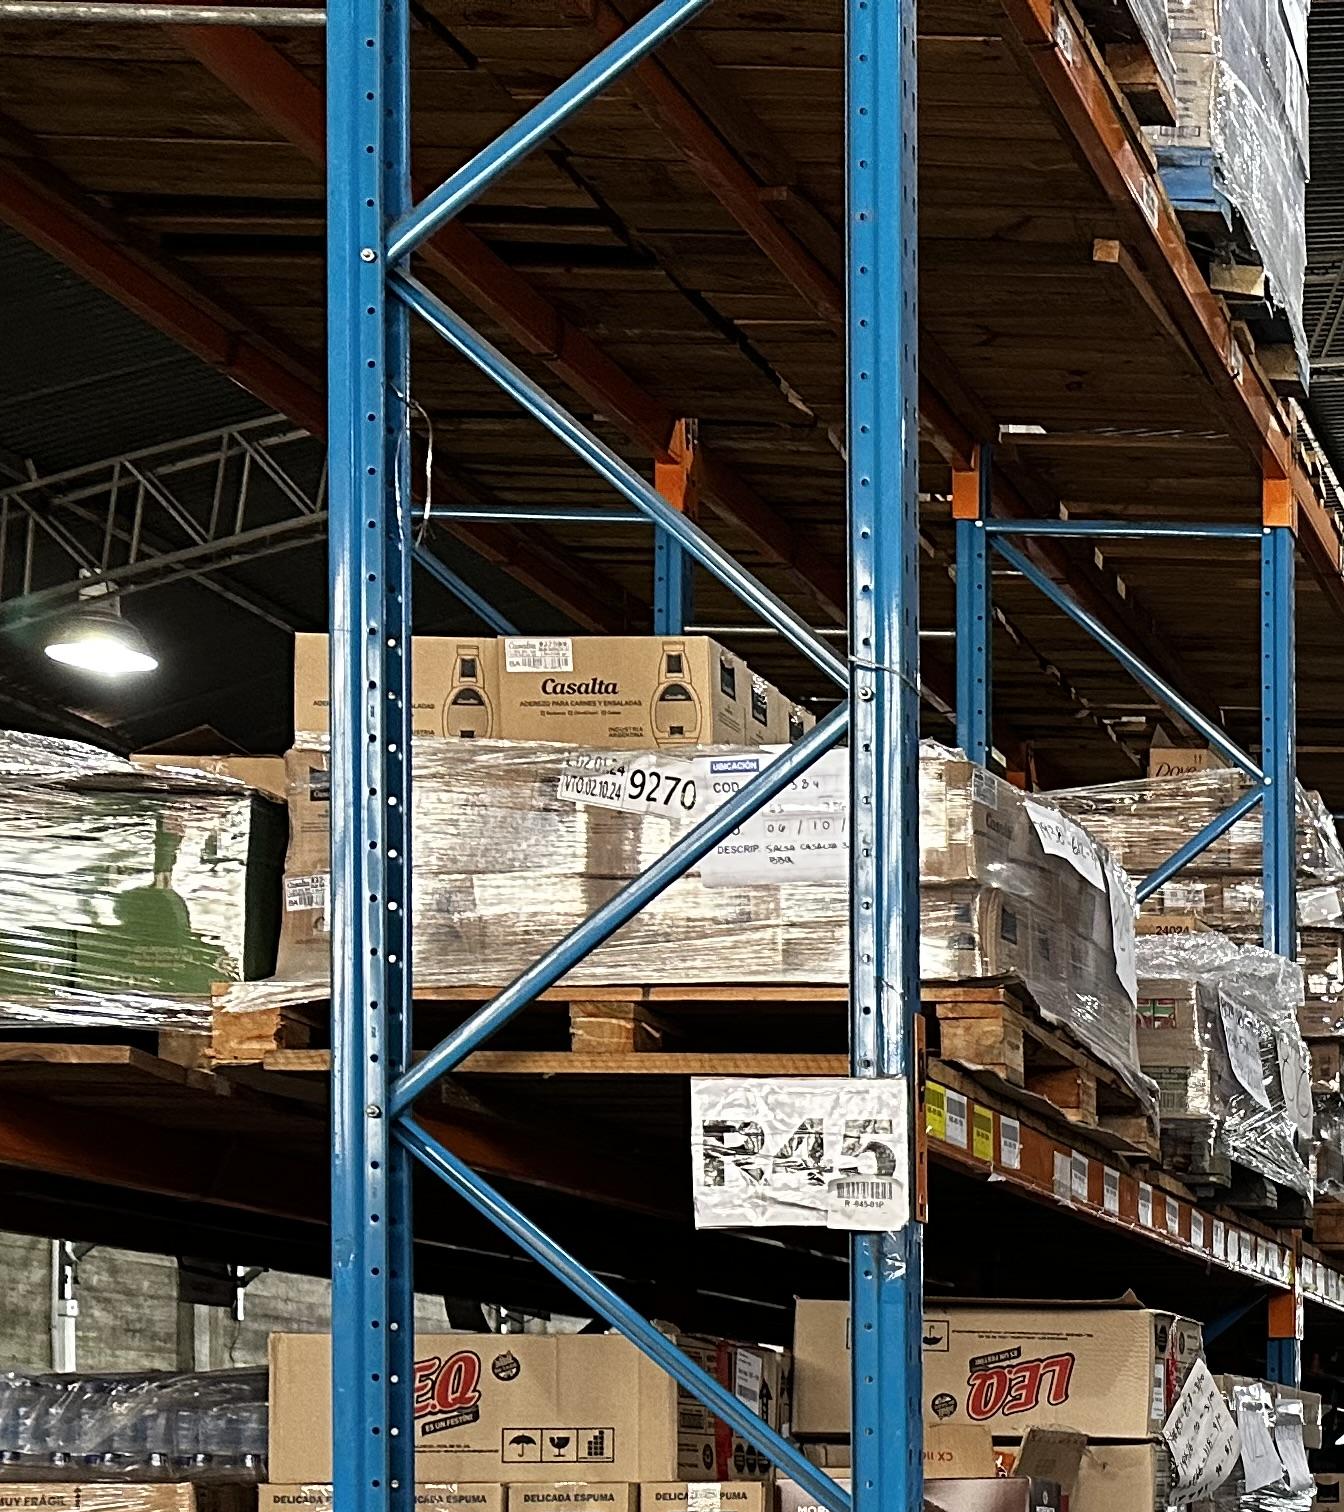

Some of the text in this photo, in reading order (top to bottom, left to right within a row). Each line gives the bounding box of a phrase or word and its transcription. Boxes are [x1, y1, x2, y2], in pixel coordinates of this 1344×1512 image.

[541, 677, 619, 695] Casalta
[628, 769, 697, 810] 9270
[702, 1118, 897, 1187] R45
[273, 1496, 323, 1504] DELICADA
[446, 1495, 487, 1504] ESPUMA
[524, 1493, 615, 1503] DELICADA ESPUMA
[719, 1492, 748, 1501] PUMA
